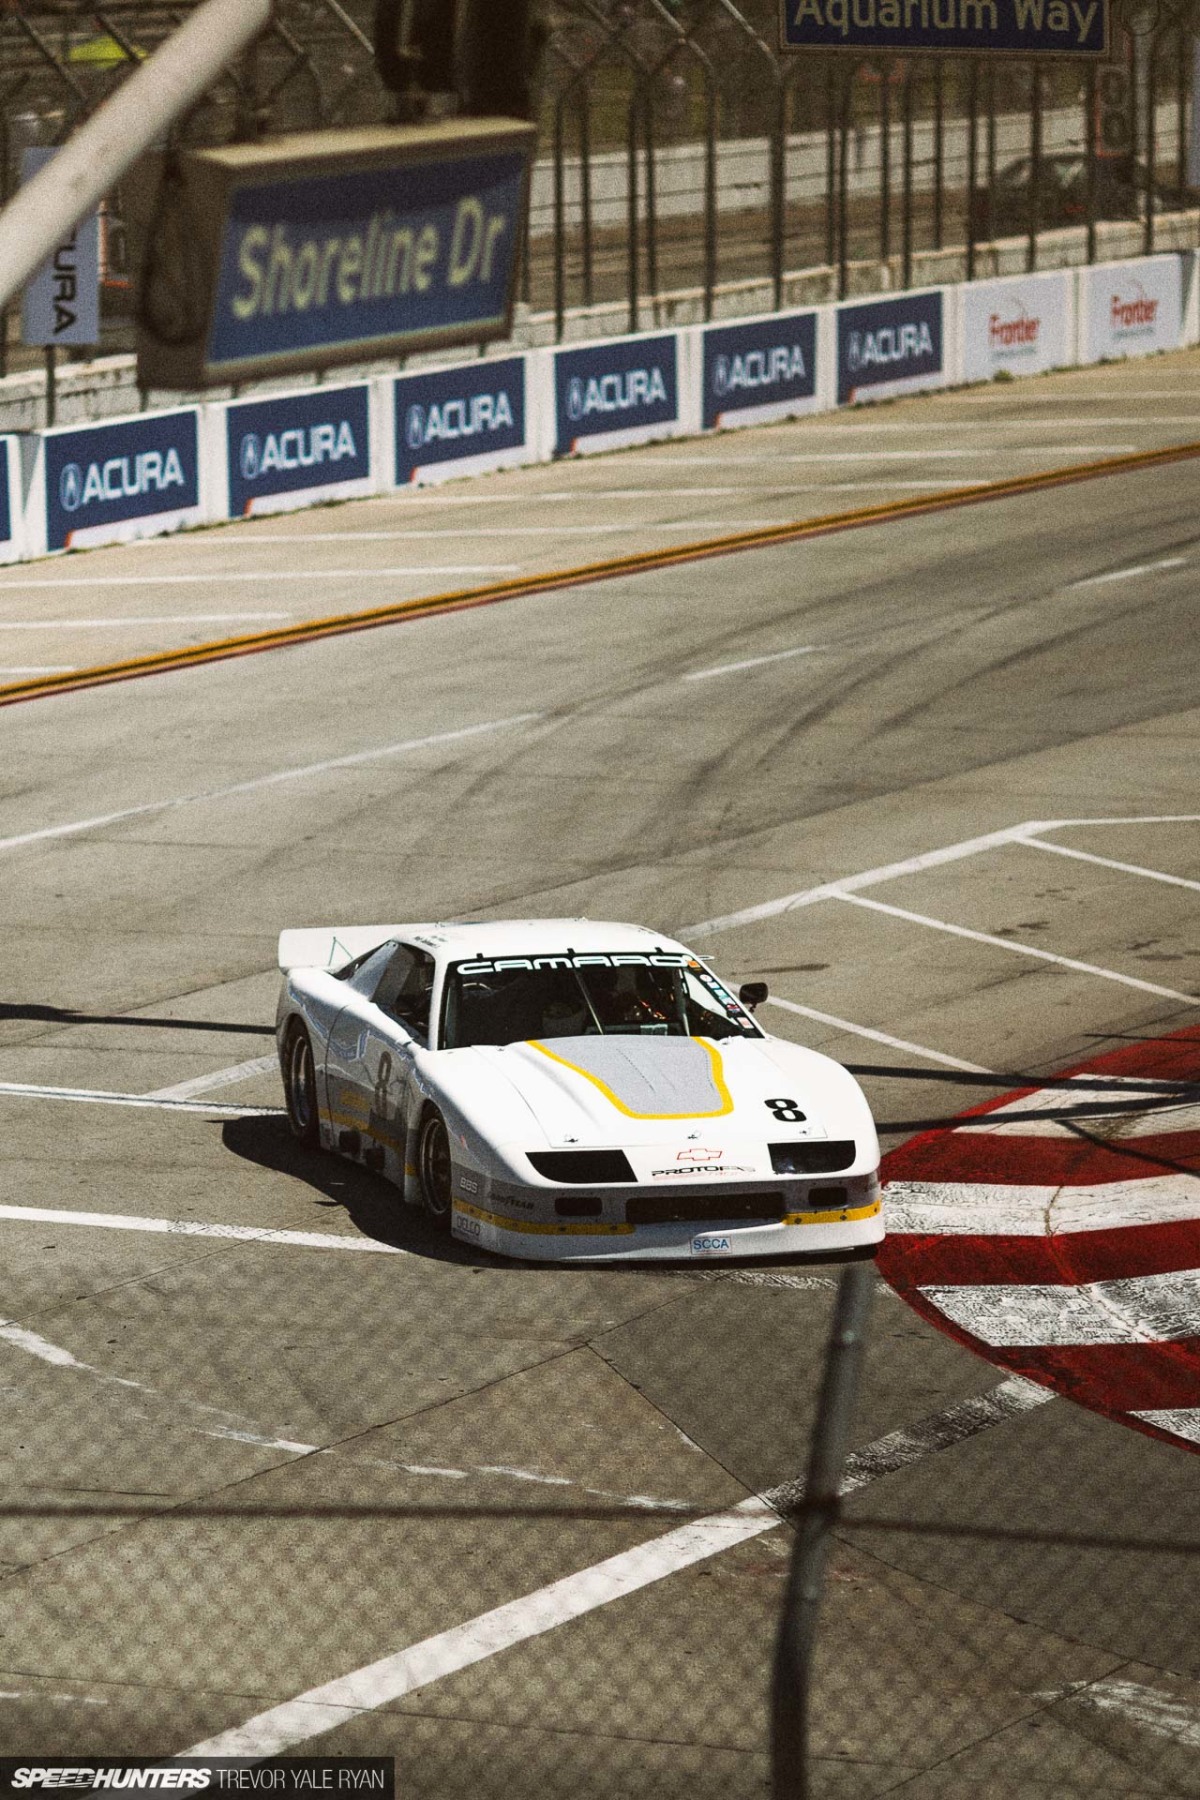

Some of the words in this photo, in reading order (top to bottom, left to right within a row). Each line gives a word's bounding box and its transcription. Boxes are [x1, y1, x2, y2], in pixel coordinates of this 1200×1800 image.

[794, 0, 998, 36] Aquarium
[1013, 0, 1099, 43] Way
[232, 208, 437, 320] Shoreline
[447, 195, 507, 288] Dr
[727, 343, 807, 390] ACURA
[859, 320, 935, 367] ACURA
[582, 367, 669, 416] ACURA
[422, 390, 515, 443] ACURA
[259, 420, 357, 468] ACURA
[81, 446, 185, 505] ACURA
[456, 954, 691, 976] CAMARO
[764, 1098, 808, 1123] 8
[459, 1177, 479, 1195] BBS
[693, 1238, 730, 1250] SCCA
